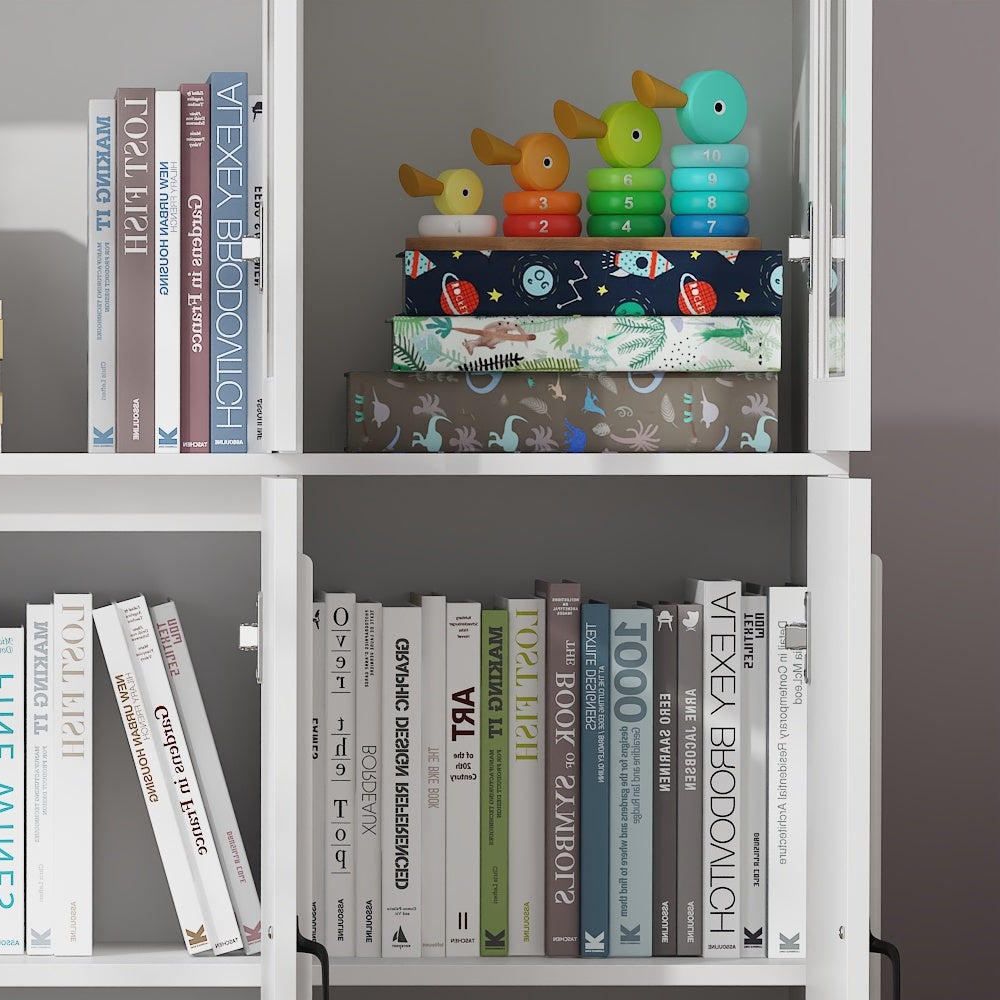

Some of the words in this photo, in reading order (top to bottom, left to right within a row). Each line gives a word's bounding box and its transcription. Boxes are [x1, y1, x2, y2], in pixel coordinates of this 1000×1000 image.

[704, 150, 721, 162] 10
[623, 174, 632, 186] 6
[707, 174, 717, 185] 9
[539, 197, 548, 209] 3
[625, 197, 633, 209] 5
[707, 197, 717, 209] 8
[540, 221, 548, 232] 2
[621, 221, 631, 232] 4
[707, 220, 716, 232] 7
